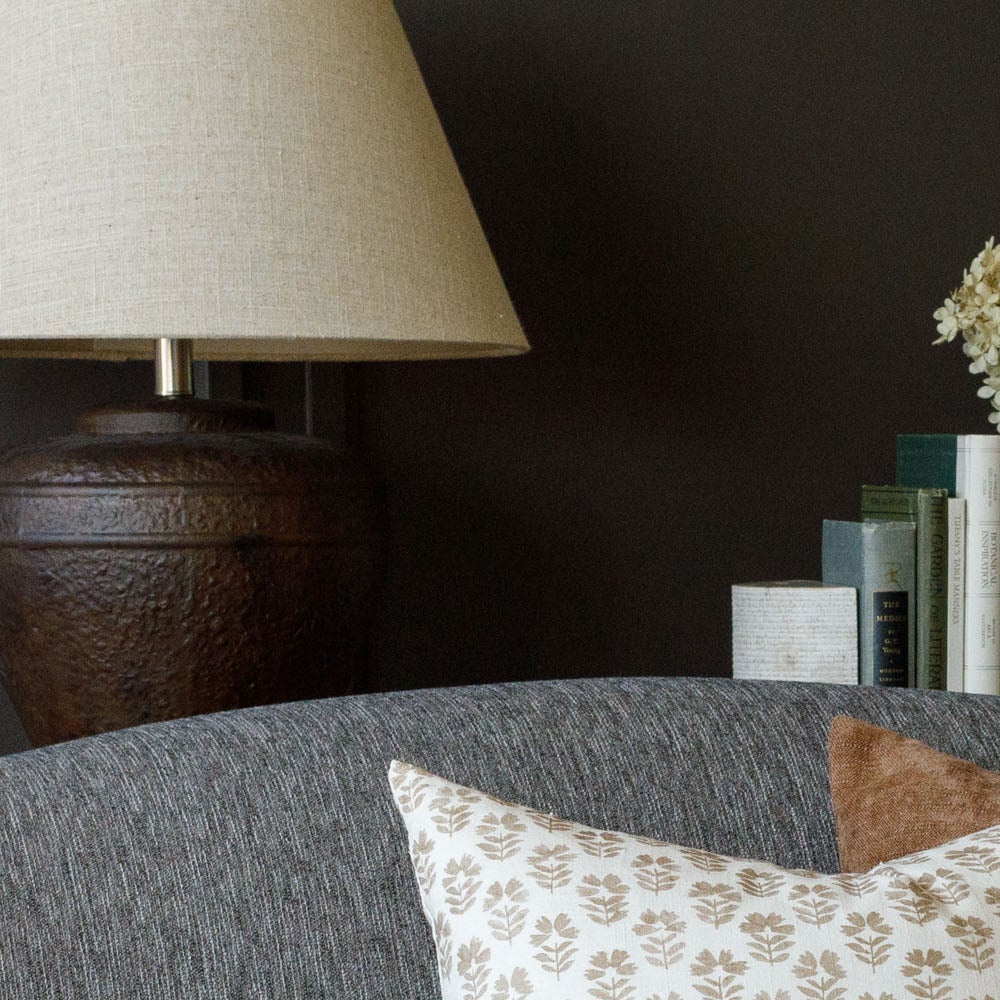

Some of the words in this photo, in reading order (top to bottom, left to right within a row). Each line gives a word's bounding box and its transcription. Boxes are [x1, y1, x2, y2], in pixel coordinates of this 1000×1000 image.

[931, 497, 944, 525] THE
[930, 534, 944, 599] GARDEN
[952, 558, 961, 581] TABLE
[981, 530, 990, 588] INSPIRATION
[989, 532, 998, 587] BOTANICAL
[952, 584, 961, 625] MANNERS
